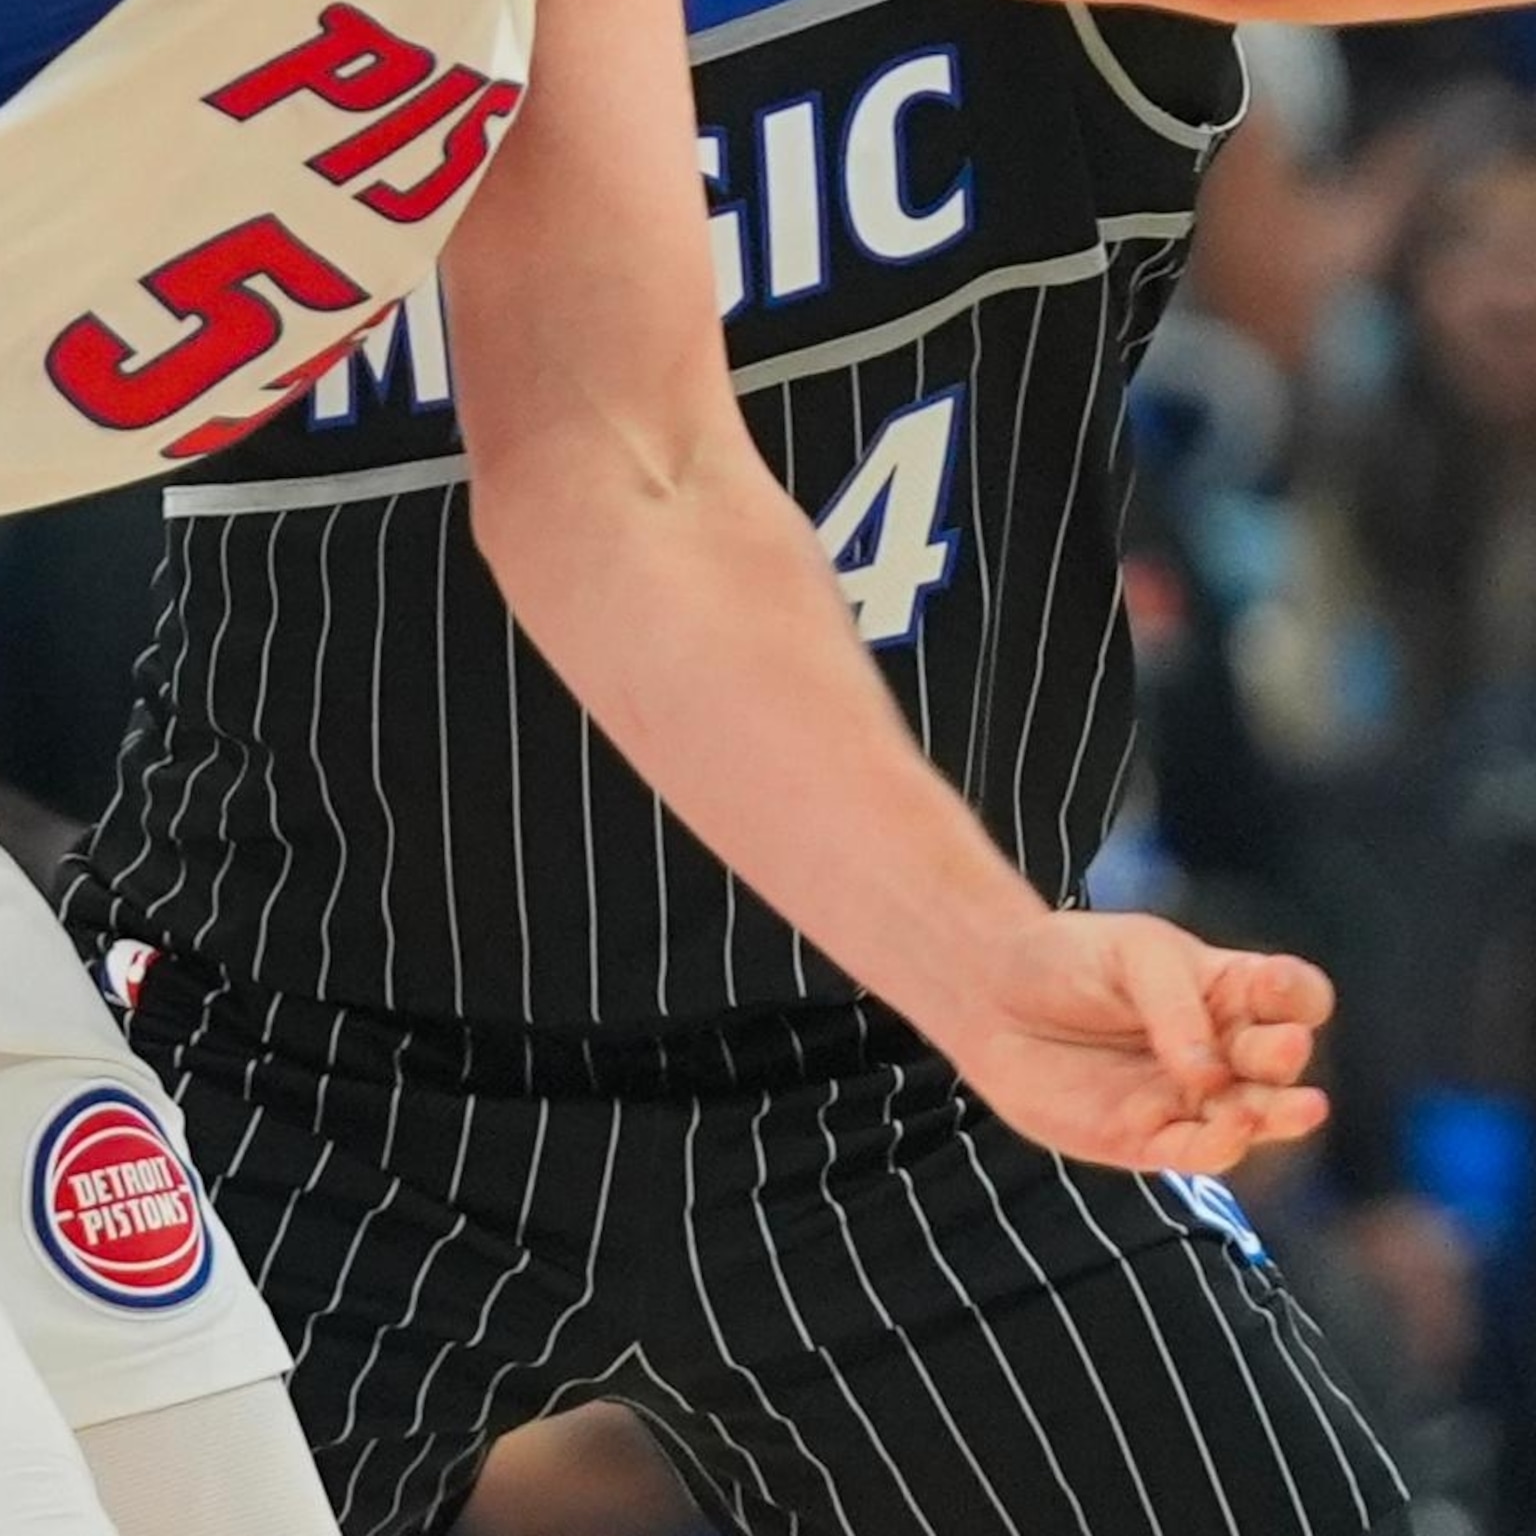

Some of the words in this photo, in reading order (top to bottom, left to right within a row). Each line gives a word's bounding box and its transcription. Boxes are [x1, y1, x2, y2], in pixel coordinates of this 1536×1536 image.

[45, 212, 400, 458] 5
[812, 382, 964, 651] 4
[68, 1156, 175, 1209] DETROIT
[78, 1191, 188, 1247] PISTONS
